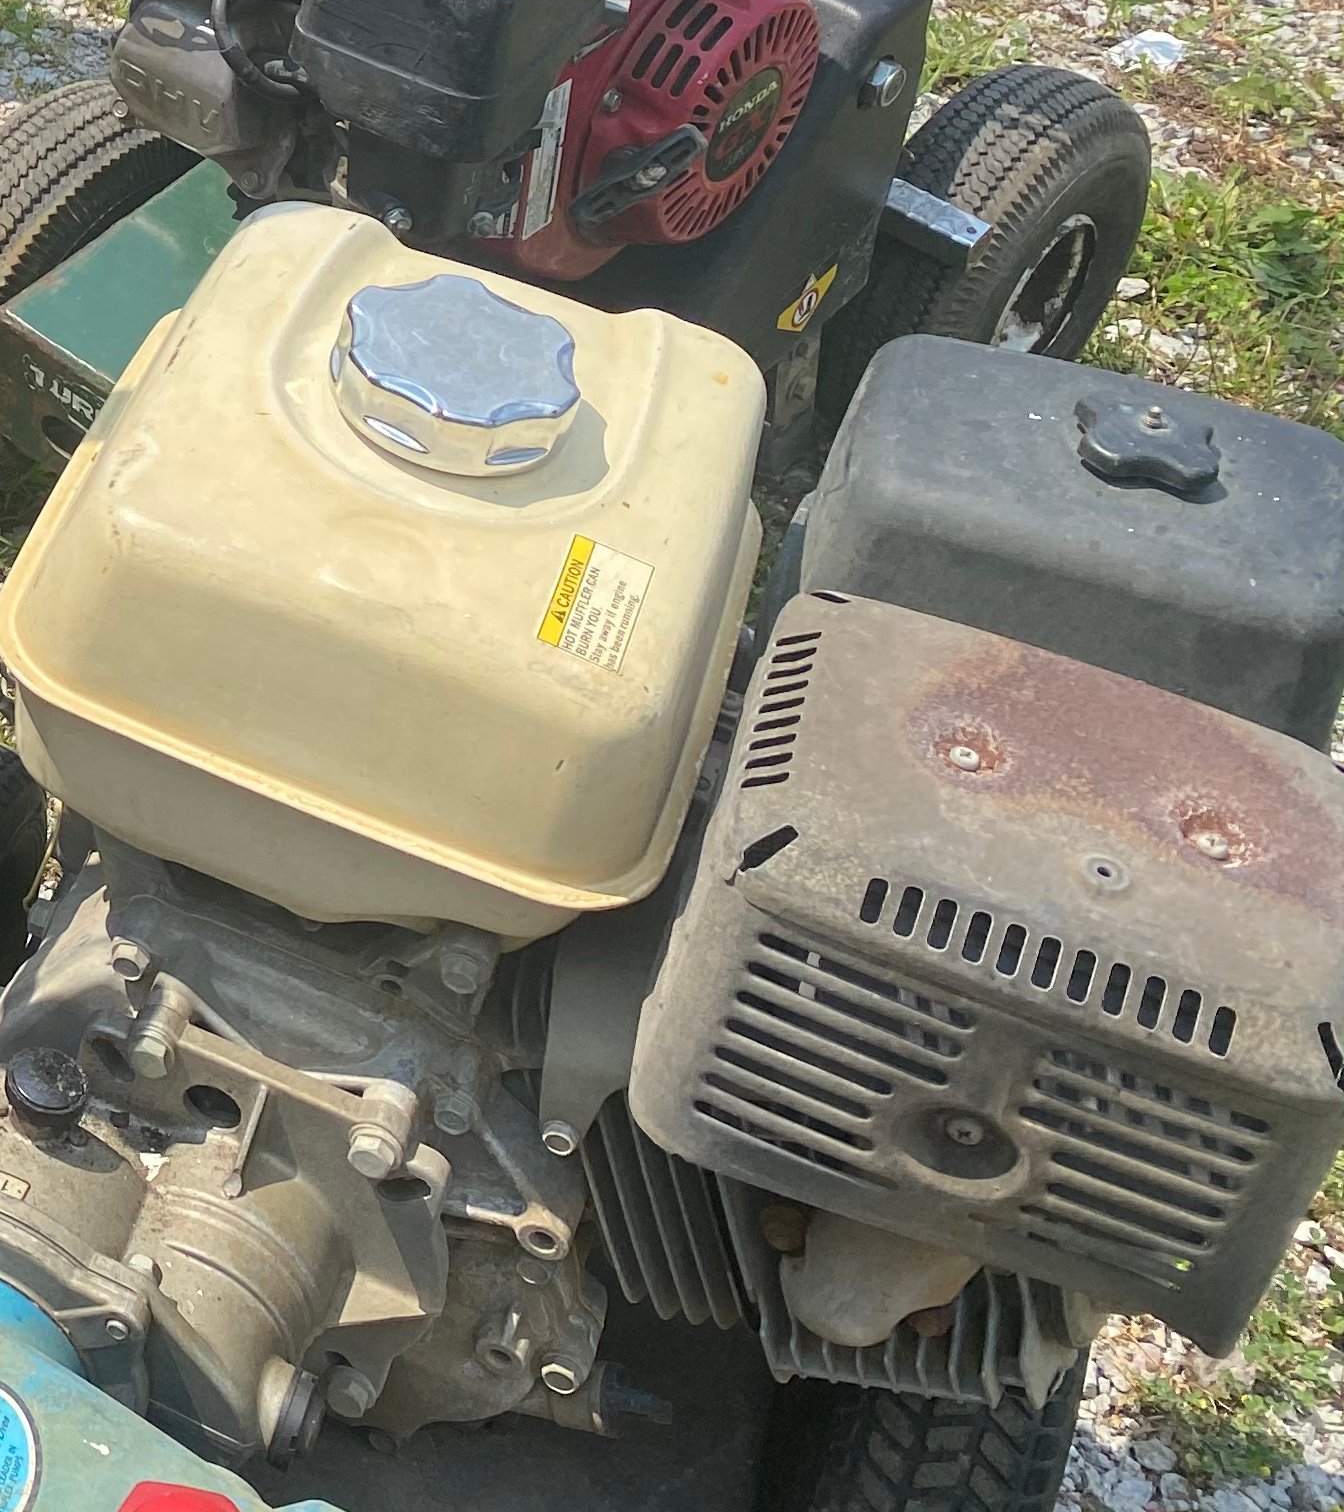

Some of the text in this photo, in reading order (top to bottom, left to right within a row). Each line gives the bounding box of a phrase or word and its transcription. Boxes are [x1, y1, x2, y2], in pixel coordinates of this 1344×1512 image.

[718, 81, 778, 133] HONDA
[29, 364, 100, 422] TUR
[557, 558, 584, 608] CAUTION
[562, 567, 600, 649] HOT MUFFLER CAN
[576, 630, 594, 656] BURN
[589, 643, 607, 663] Stay
[599, 619, 616, 643] away
[611, 580, 627, 609] engine
[603, 655, 618, 668] has
[612, 629, 625, 653] been
[0, 1415, 11, 1441] Lives
